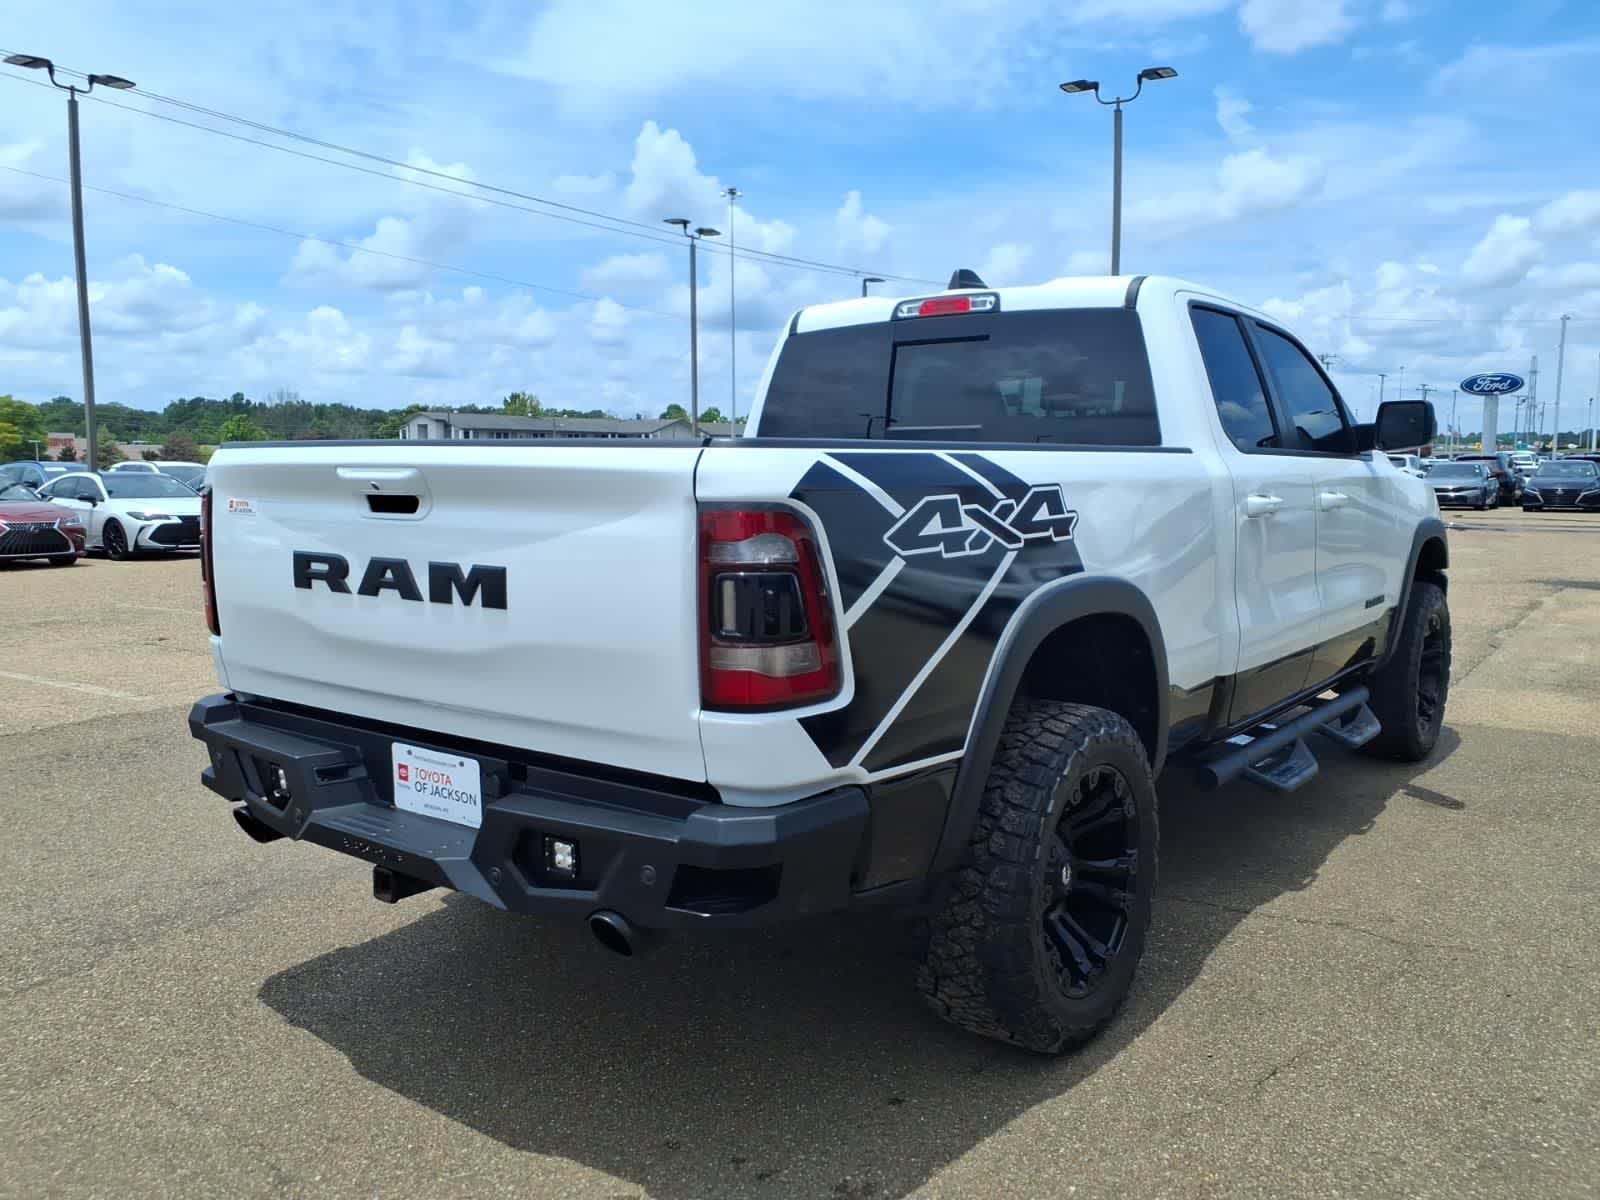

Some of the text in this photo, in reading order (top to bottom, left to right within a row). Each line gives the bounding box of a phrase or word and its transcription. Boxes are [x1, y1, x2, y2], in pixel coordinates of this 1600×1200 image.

[1473, 376, 1512, 391] Ford
[293, 550, 508, 610] RAM
[415, 768, 453, 785] TOYOTA
[415, 781, 429, 793] OF
[430, 784, 477, 806] JACKSON
